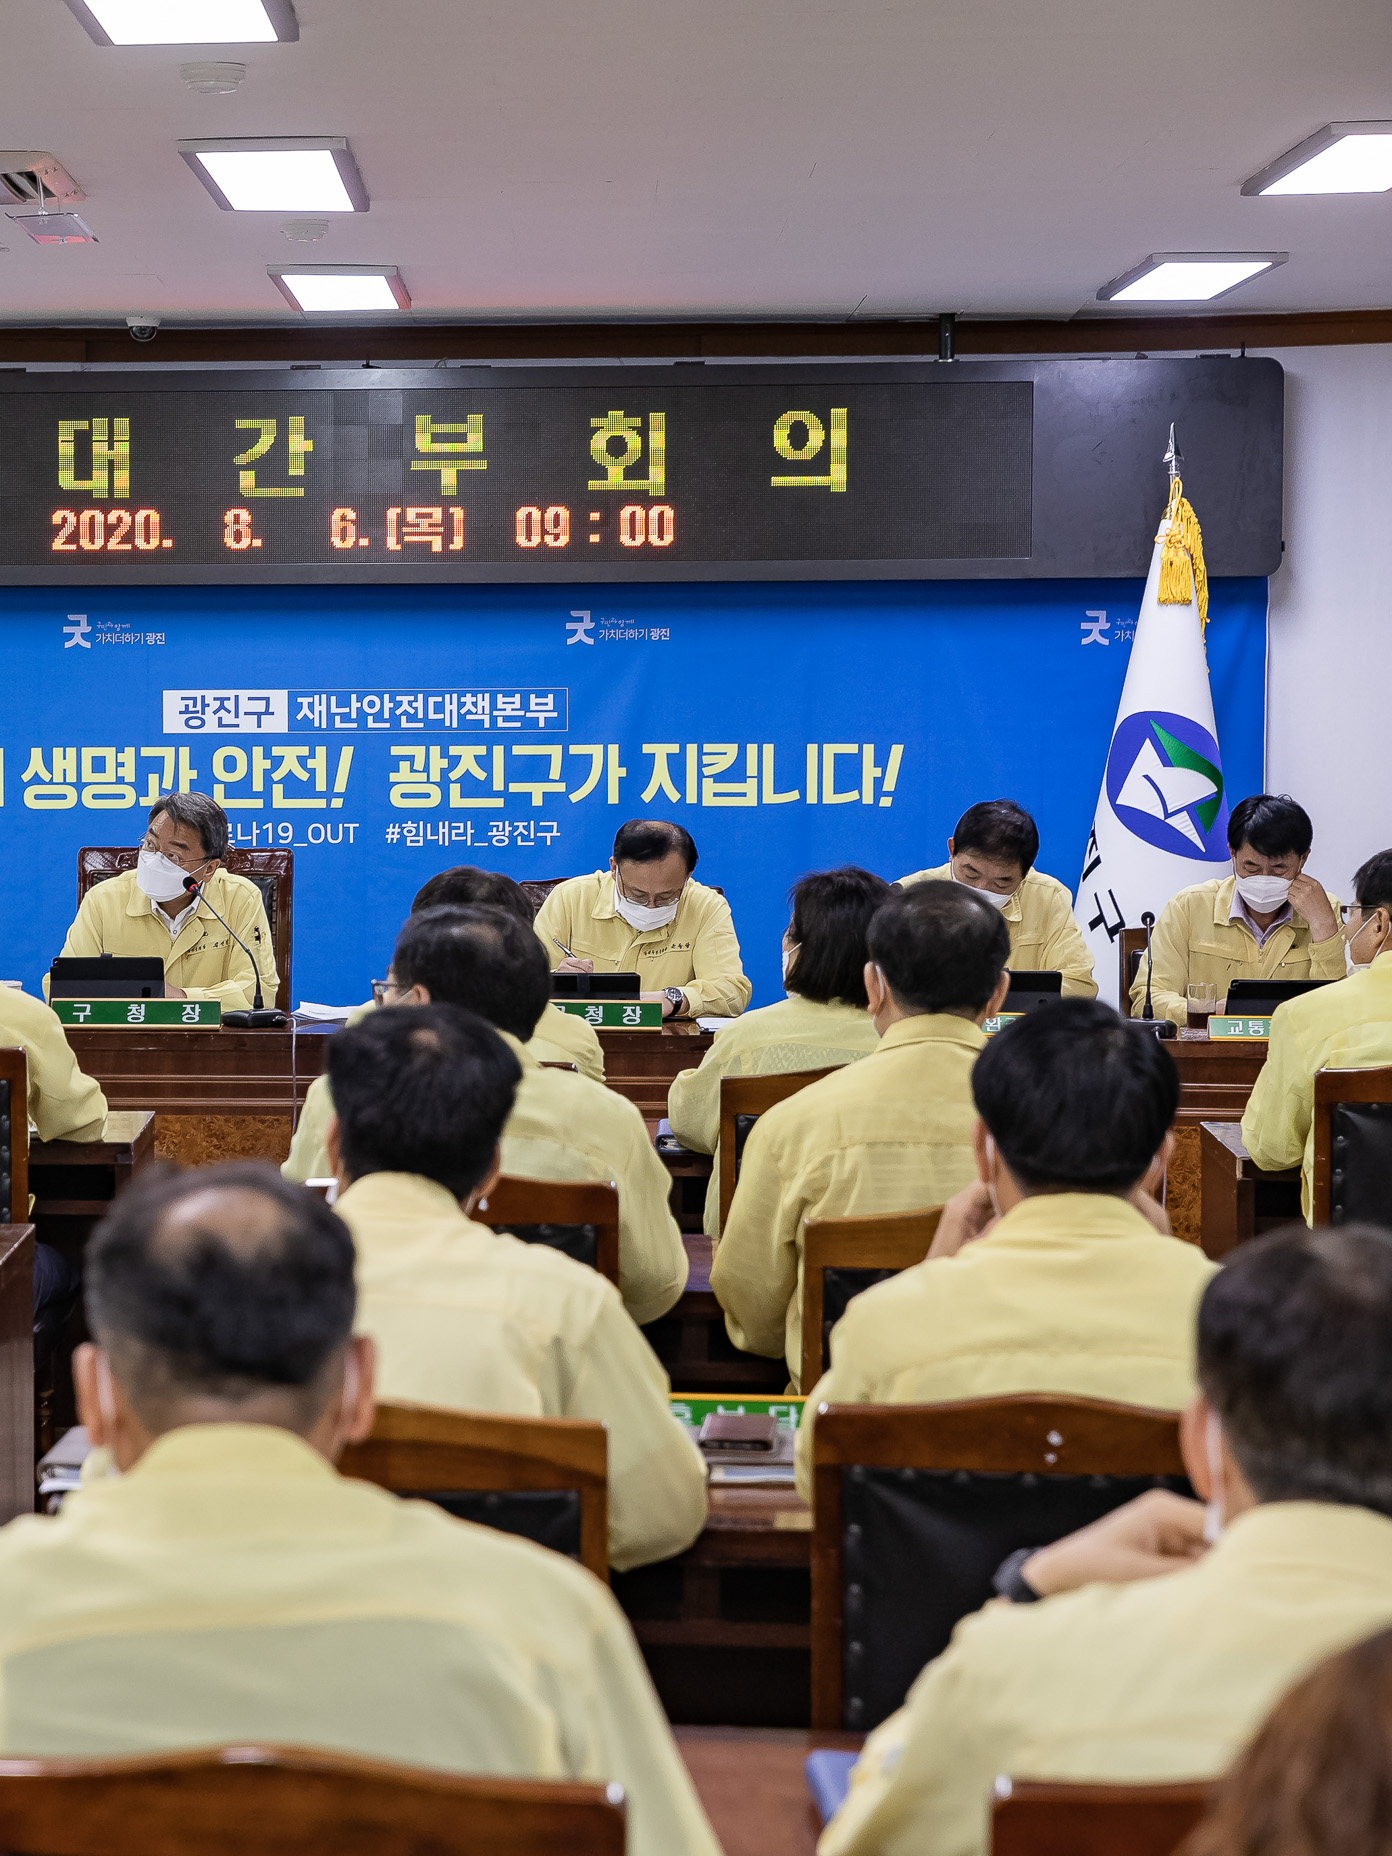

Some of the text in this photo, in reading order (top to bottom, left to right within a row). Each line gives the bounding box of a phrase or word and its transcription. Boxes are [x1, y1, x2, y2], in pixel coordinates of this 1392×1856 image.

[51, 508, 173, 550] 2020.
[223, 508, 262, 549] 8.
[95, 632, 166, 645] 가치더하기 광진
[598, 627, 670, 641] 가치더하기 광진
[178, 692, 559, 730] 광진구 재난안전대책본부
[20, 746, 198, 810] 생명과
[212, 745, 355, 809] 안전!
[388, 743, 627, 807] 광진구가
[641, 742, 904, 807] 지킵니다!
[385, 820, 561, 847] #힘내라_광진구
[1227, 1020, 1272, 1036] 교통
